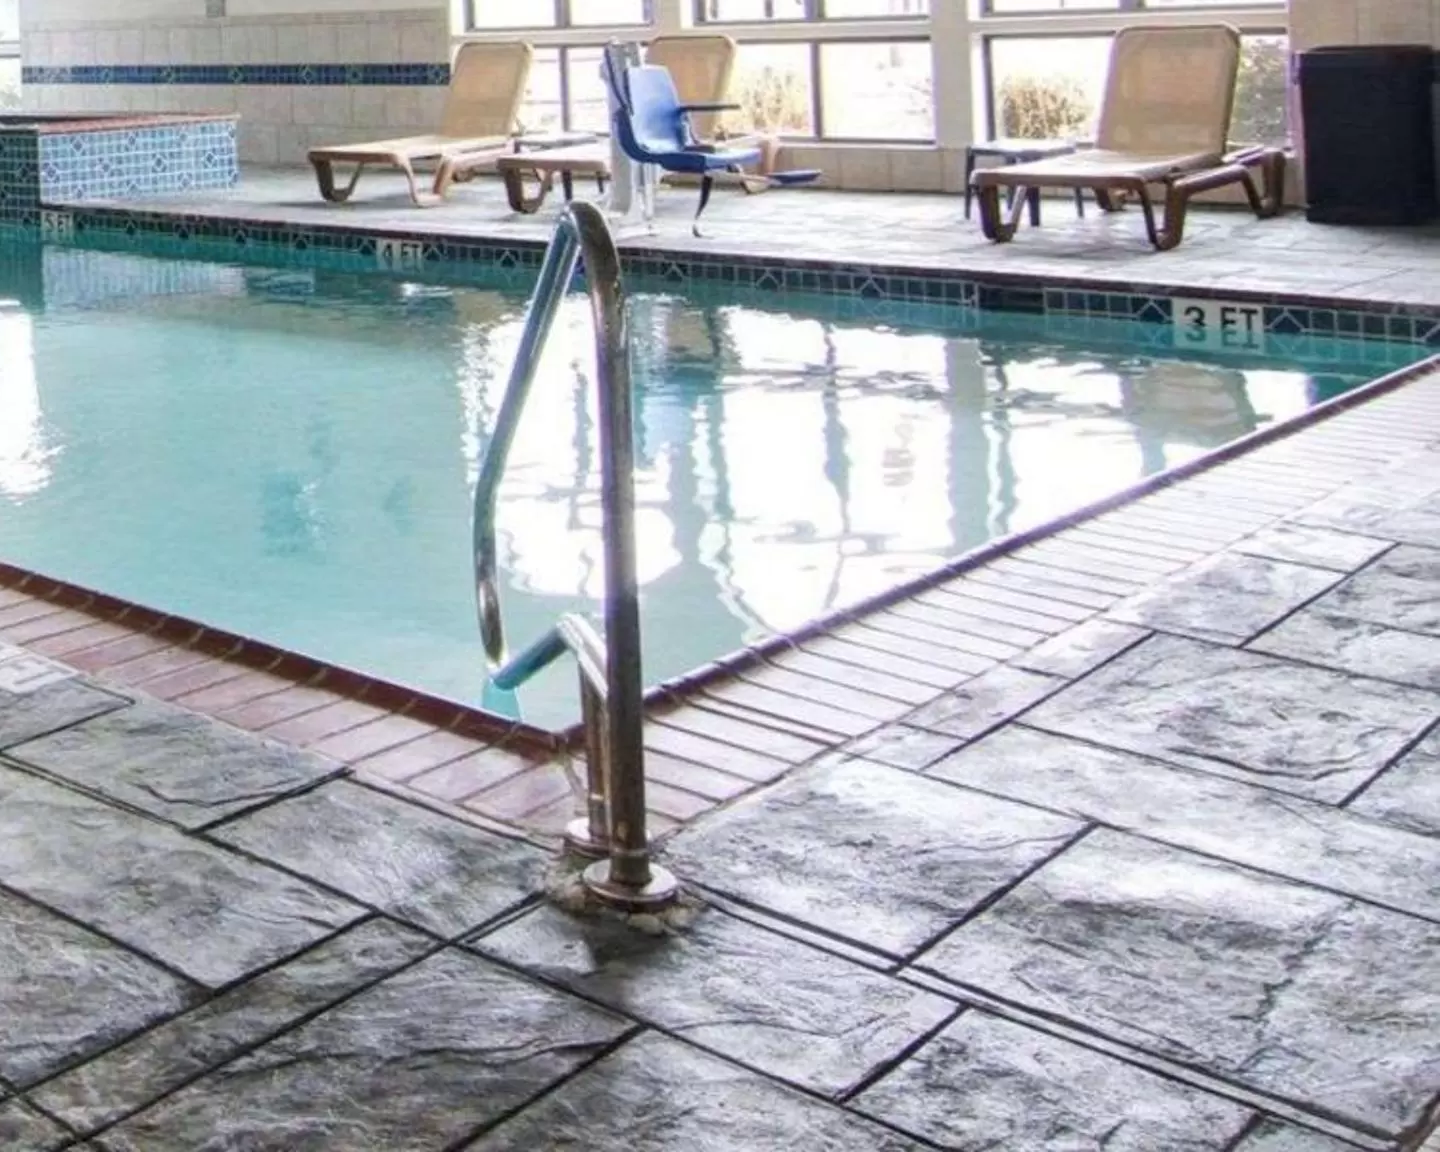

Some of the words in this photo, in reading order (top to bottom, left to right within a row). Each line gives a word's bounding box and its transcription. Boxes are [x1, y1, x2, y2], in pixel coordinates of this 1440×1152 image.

[57, 213, 70, 233] FT
[1184, 305, 1205, 330] 3
[1220, 306, 1258, 331] FT
